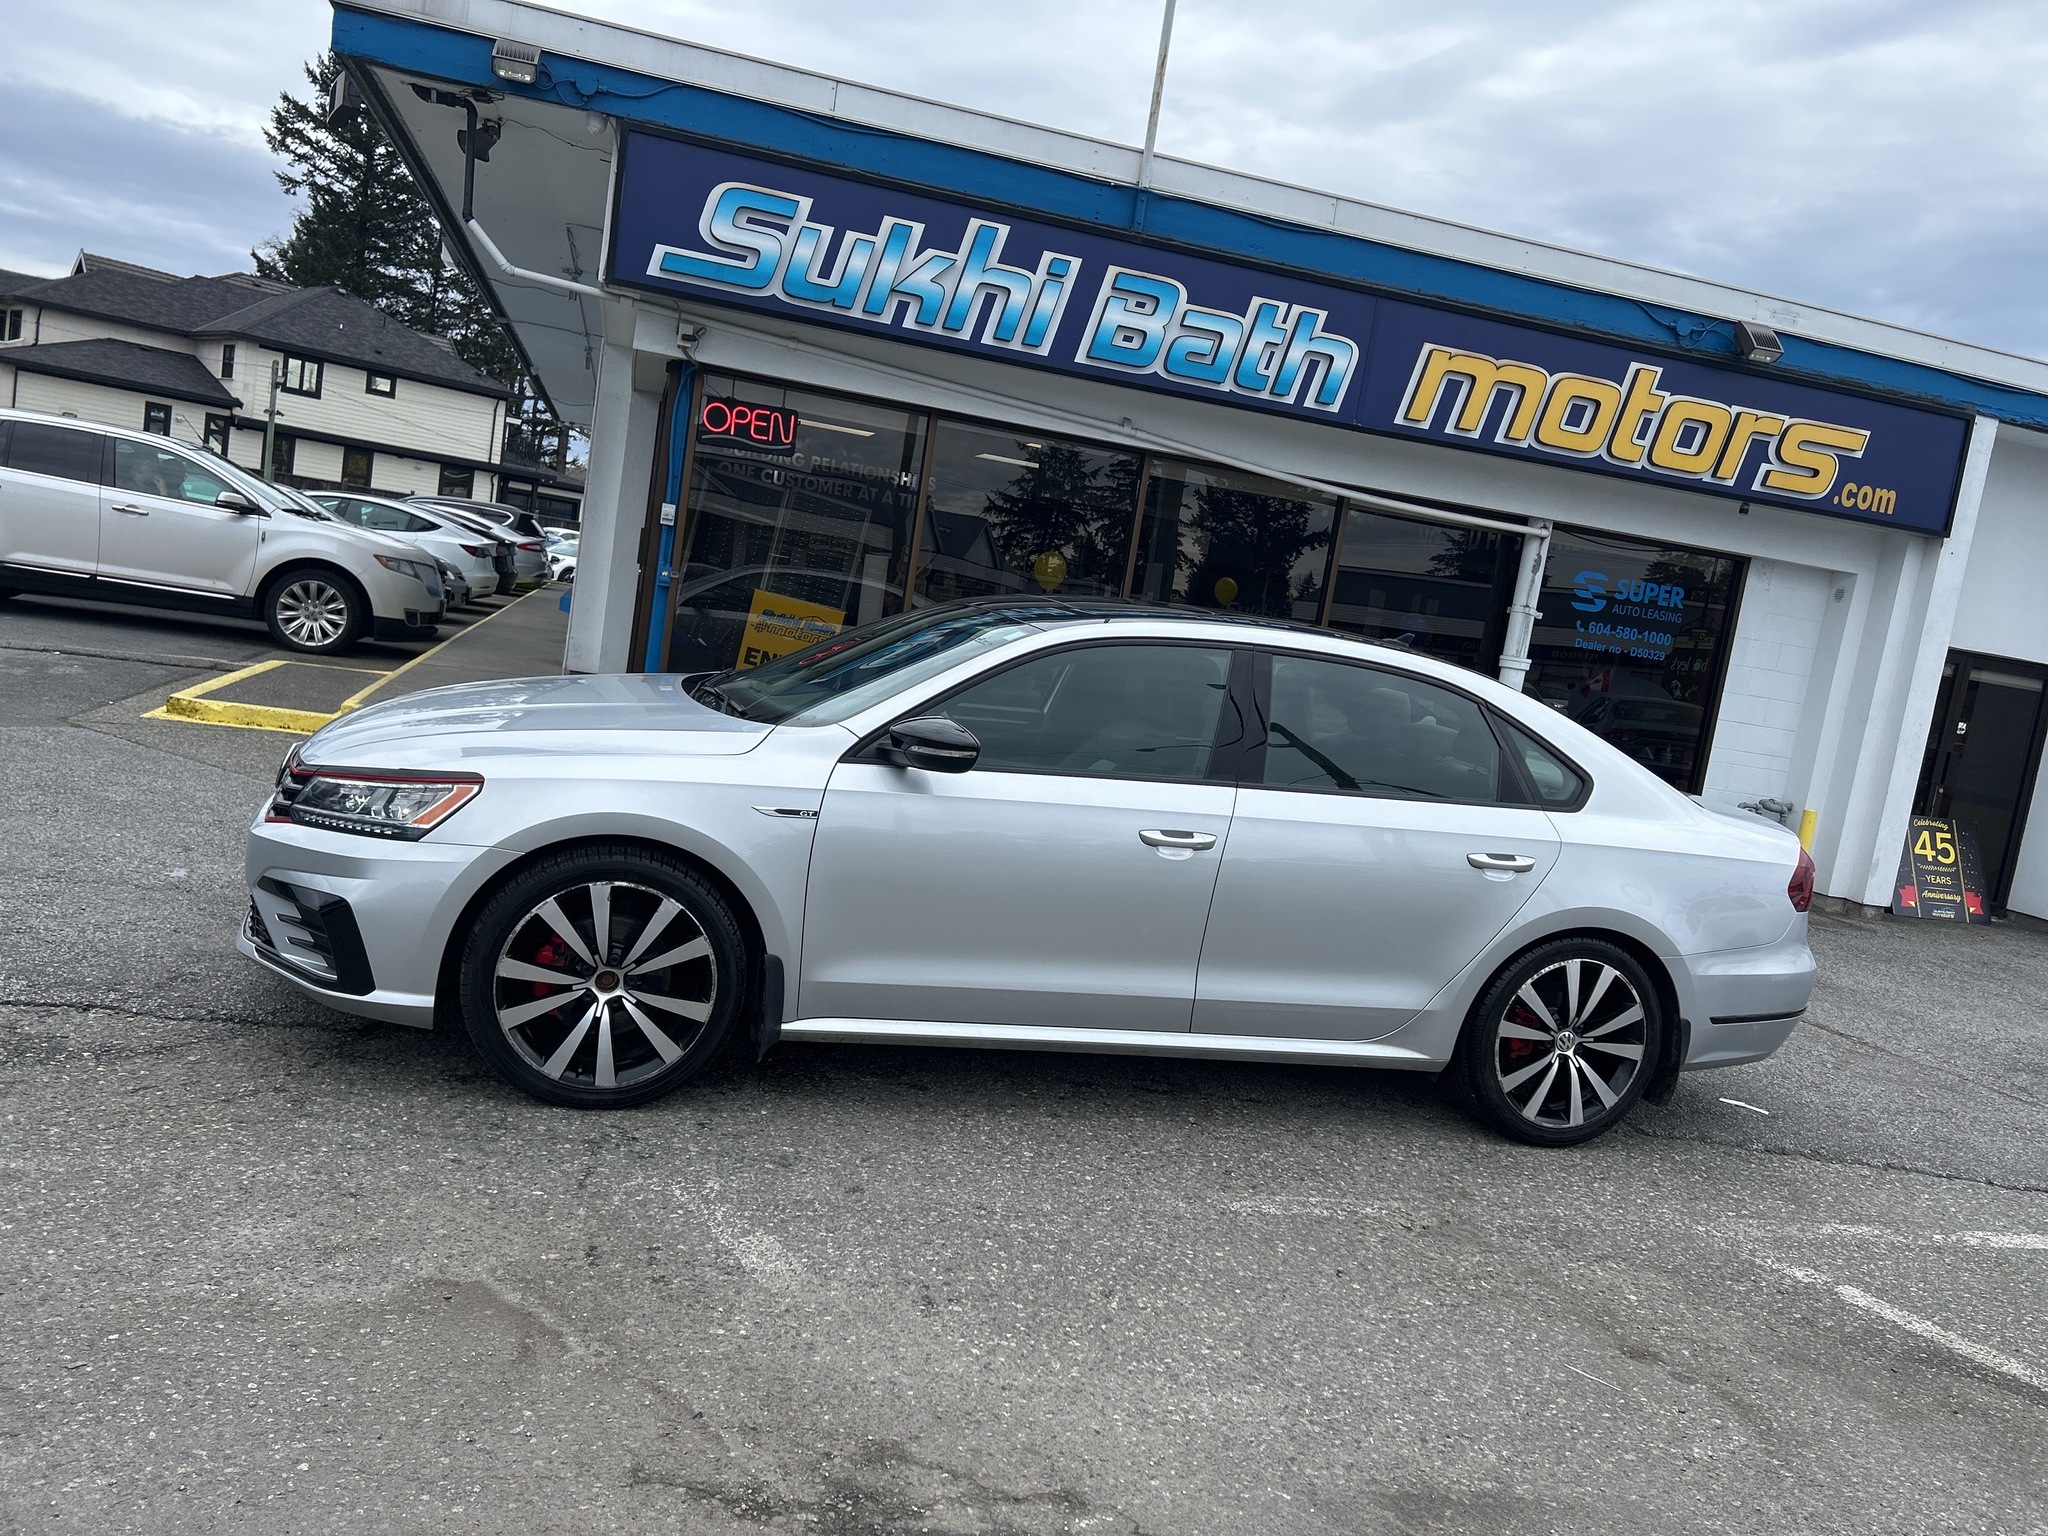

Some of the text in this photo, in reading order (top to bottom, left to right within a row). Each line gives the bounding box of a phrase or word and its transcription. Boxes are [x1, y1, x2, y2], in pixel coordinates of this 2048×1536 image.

[646, 181, 1081, 357] Sukhi
[1076, 264, 1360, 413] Bath
[1395, 342, 1871, 501] motors
[702, 402, 795, 444] OPEN
[761, 468, 853, 498] CUSTOMER
[858, 486, 877, 502] AT
[881, 489, 895, 506] A
[811, 455, 937, 492] RELATIONSHIS
[1614, 577, 1685, 609] SUPER
[1612, 604, 1683, 624] AUTO LEASING
[1588, 621, 1673, 646] 604-580-1000
[1575, 637, 1607, 652] Dealer
[1609, 643, 1622, 655] no
[1630, 646, 1666, 662] D50329
[1913, 818, 1949, 831] Celebrating
[1914, 830, 1956, 865] 45
[1925, 874, 1952, 885] YEARS
[1921, 890, 1962, 903] Anniversary
